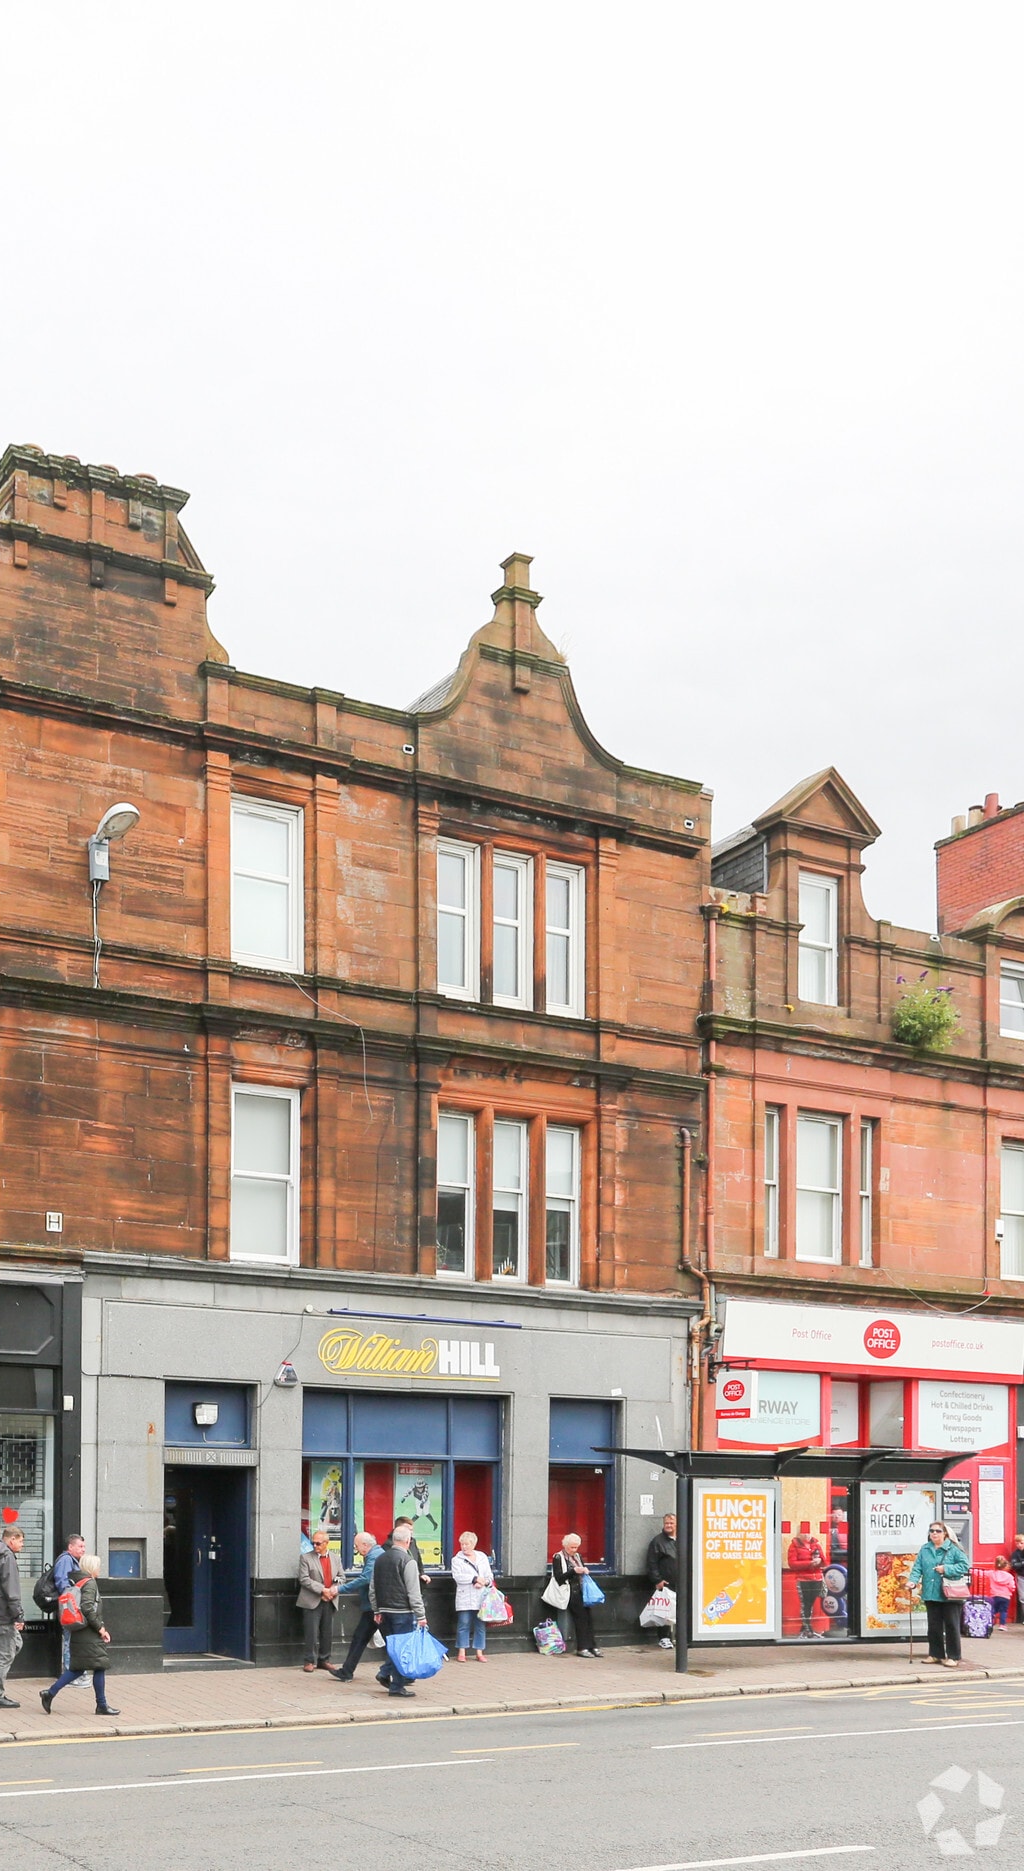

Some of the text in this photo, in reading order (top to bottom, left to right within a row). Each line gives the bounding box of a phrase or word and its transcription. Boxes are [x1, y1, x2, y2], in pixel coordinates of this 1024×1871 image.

[792, 1329, 832, 1341] Post Office
[872, 1327, 895, 1339] POST
[866, 1337, 897, 1350] OFFICE
[931, 1338, 984, 1351] postoffice.co.uk
[318, 1327, 501, 1377] William HILL
[724, 1389, 743, 1397] OFFICE
[939, 1390, 986, 1401] Confectionery
[931, 1401, 943, 1409] Hot
[950, 1402, 972, 1410] Chilled
[973, 1403, 994, 1411] Drinks
[942, 1412, 982, 1422] Fancy Goods
[943, 1424, 982, 1433] Newspapers
[950, 1435, 975, 1445] Lottery
[953, 1489, 969, 1497] Cash
[706, 1498, 766, 1517] LUNCH.
[870, 1503, 892, 1513] KFC
[706, 1517, 763, 1530] THE MOST
[870, 1513, 915, 1528] RICEBOX
[706, 1531, 763, 1539] IMPORTANT MEAL
[705, 1539, 763, 1551] OF THE DAY
[706, 1551, 721, 1559] FOR
[722, 1551, 742, 1560] OASIS
[707, 1601, 732, 1614] Oasis
